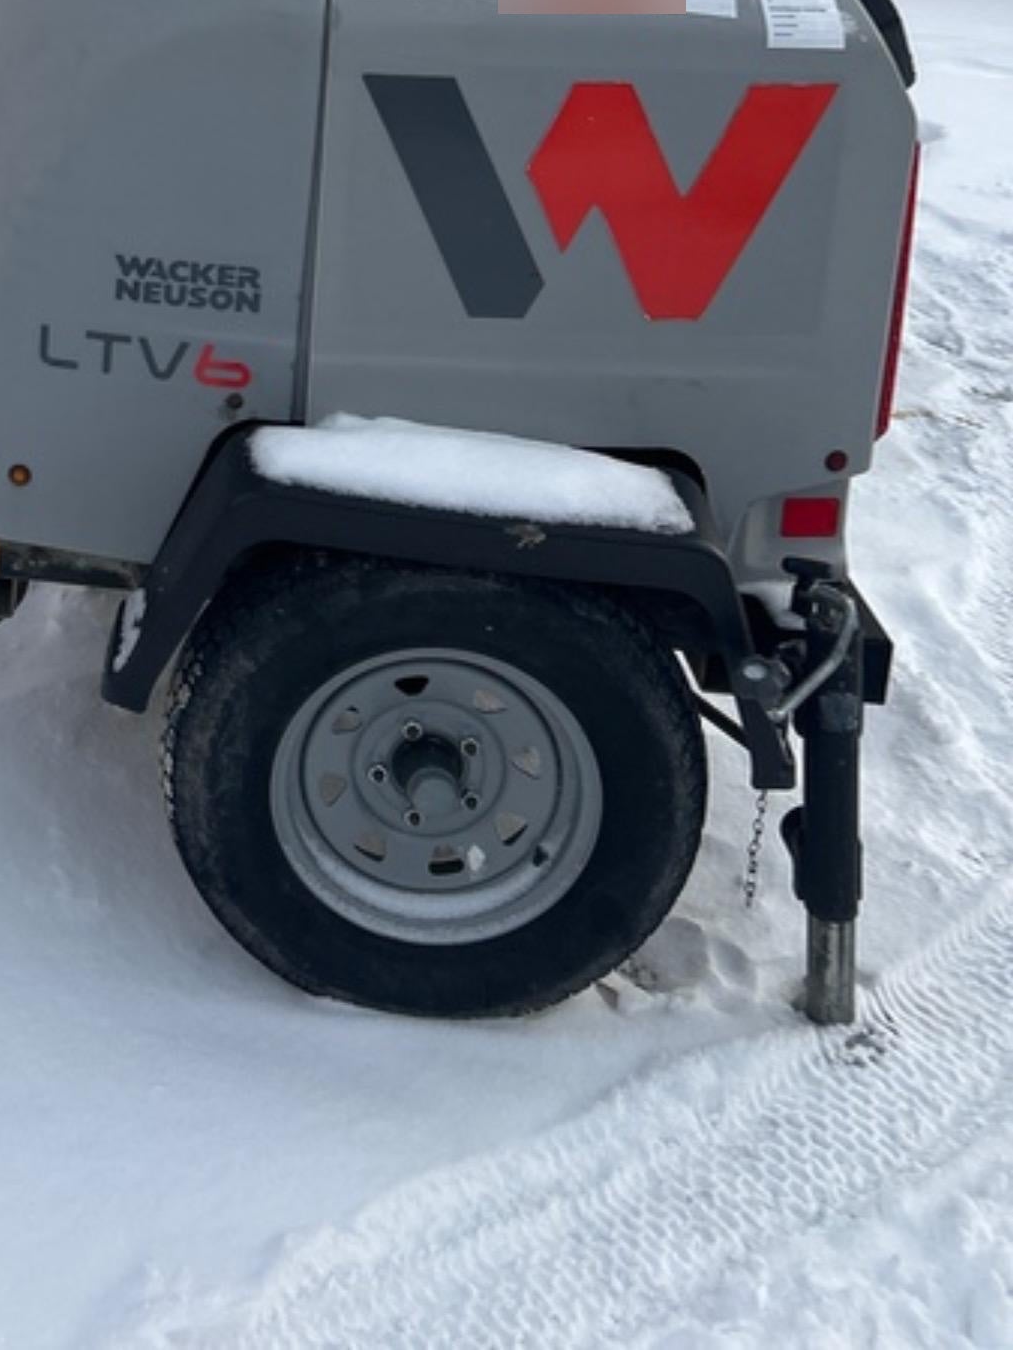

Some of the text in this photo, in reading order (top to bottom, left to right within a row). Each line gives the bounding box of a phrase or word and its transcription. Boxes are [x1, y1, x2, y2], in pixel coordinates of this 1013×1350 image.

[115, 253, 261, 290] WACKER
[115, 277, 262, 314] NEUSON
[40, 323, 253, 390] LTV6
